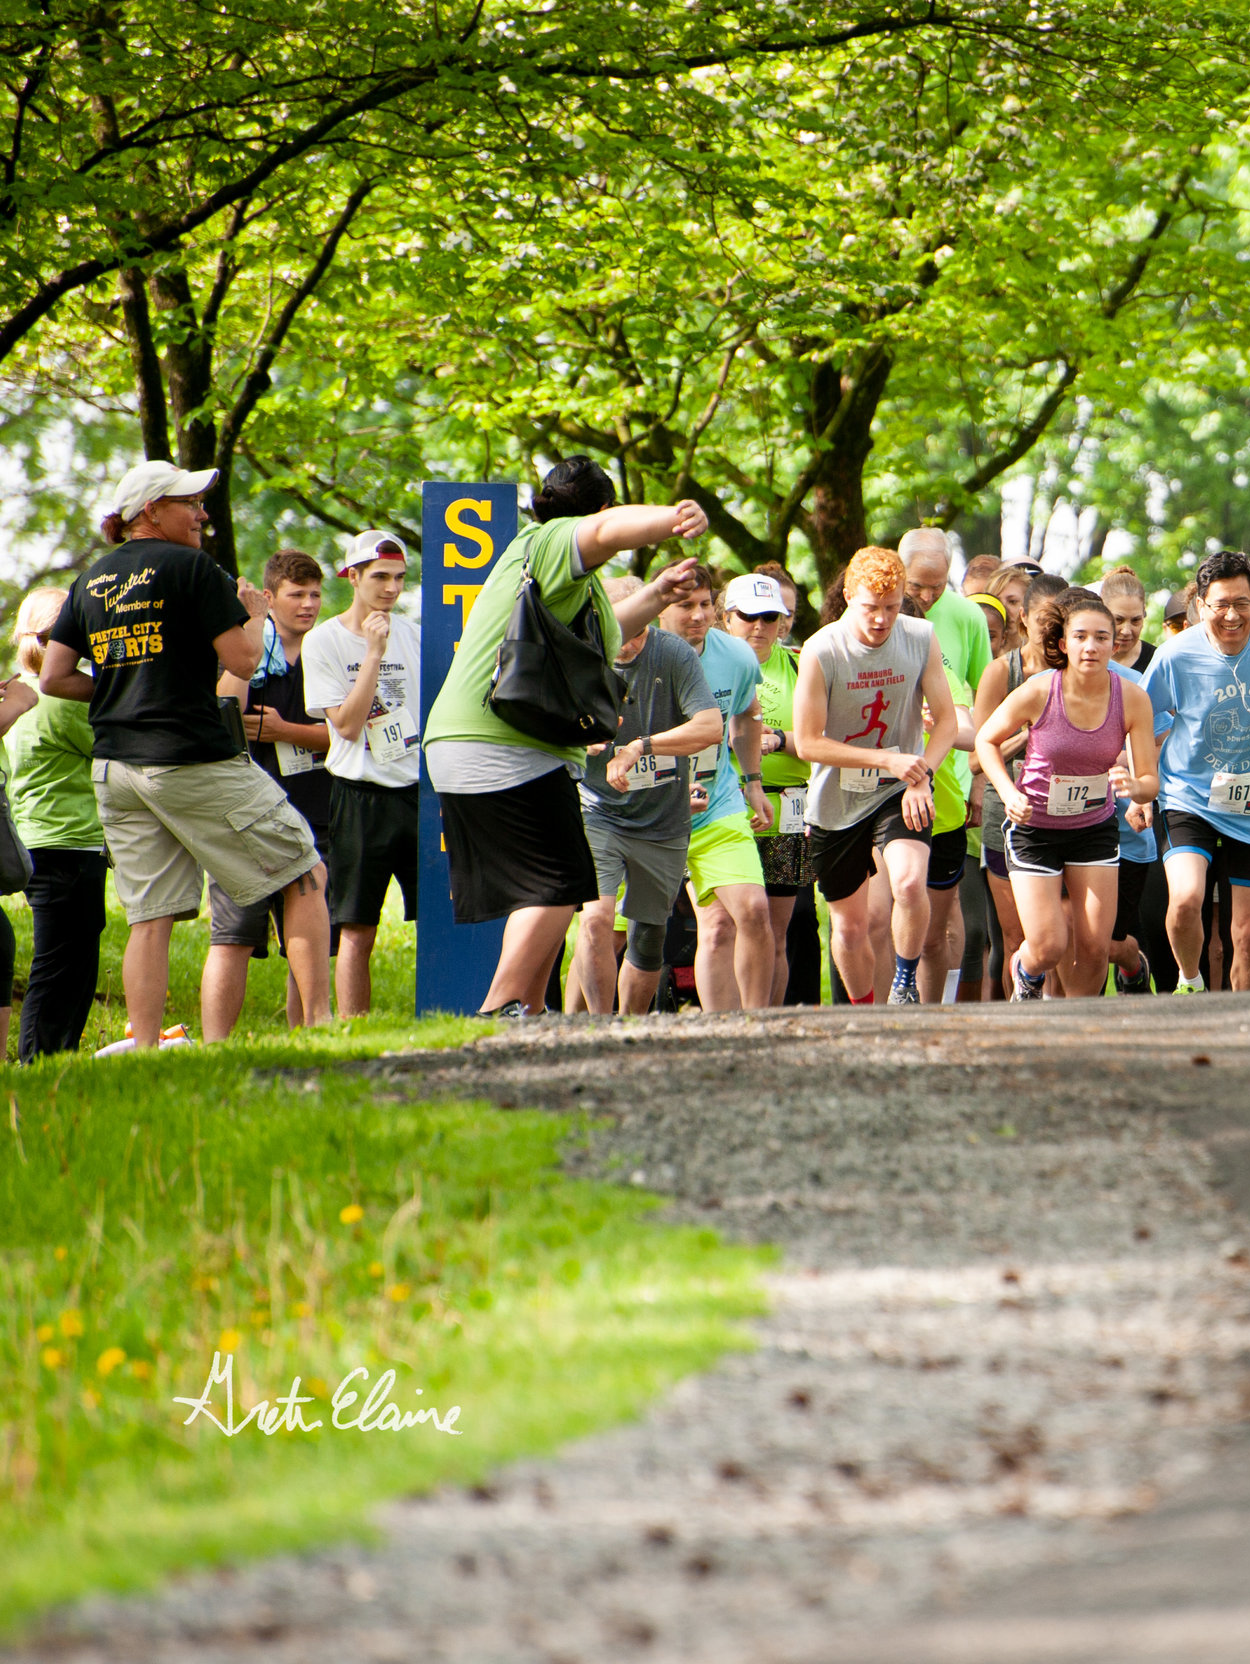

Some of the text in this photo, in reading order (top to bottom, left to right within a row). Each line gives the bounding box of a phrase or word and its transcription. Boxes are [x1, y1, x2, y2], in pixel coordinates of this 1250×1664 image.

[86, 573, 117, 590] Another
[115, 599, 164, 614] Member of
[89, 621, 162, 645] PRETZEL CITY
[857, 668, 893, 680] HAMBURG
[847, 675, 905, 690] TRACK AND FIELD
[382, 723, 403, 744] 197
[634, 755, 657, 774] 136
[1203, 753, 1239, 774] DEAF
[1068, 786, 1089, 801] 172
[1228, 785, 1250, 801] 167
